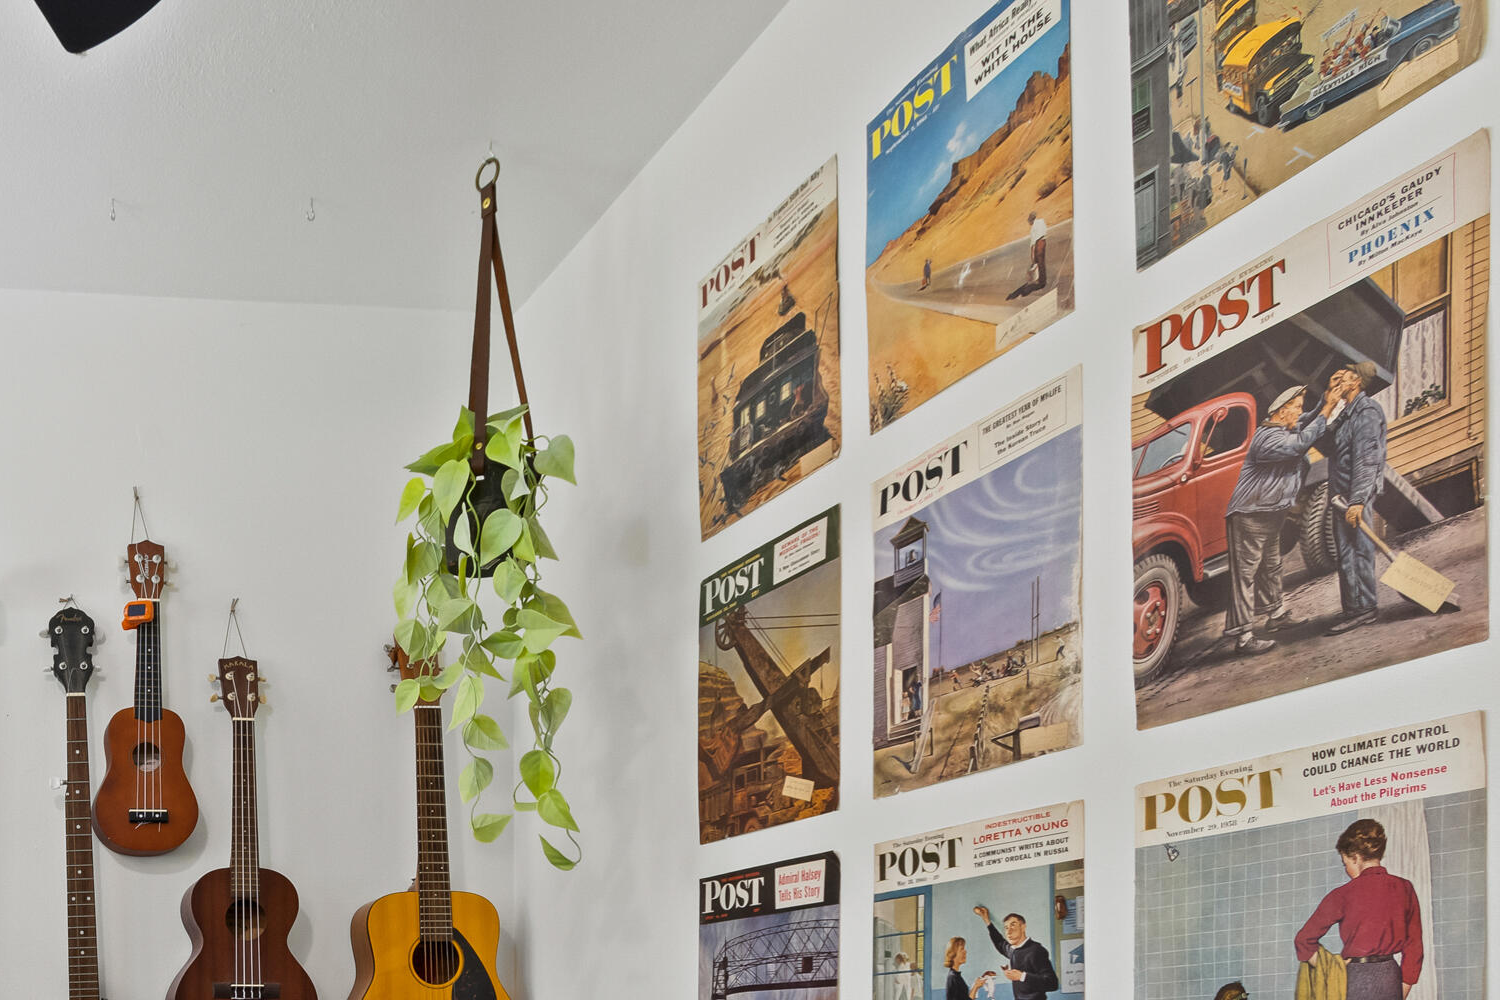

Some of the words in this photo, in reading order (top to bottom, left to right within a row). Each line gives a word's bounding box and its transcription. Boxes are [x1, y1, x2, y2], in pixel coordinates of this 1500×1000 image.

[969, 35, 987, 56] What
[989, 17, 1009, 39] Africa
[974, 50, 1009, 86] WHITE
[1012, 12, 1052, 52] HOUSE
[981, 44, 1002, 67] WIT
[1005, 32, 1016, 47] IN
[1020, 8, 1043, 32] THE
[871, 54, 958, 161] POST
[1337, 192, 1396, 231] CHICAGO'S
[1400, 166, 1443, 195] GAUDY
[1355, 187, 1423, 232] INNKEEPER
[1348, 206, 1435, 264] PHOENIX
[701, 231, 761, 309] POST
[1139, 258, 1286, 378] POST
[992, 409, 1018, 430] GREATEST
[1049, 384, 1062, 398] LIFE
[994, 439, 1005, 448] The
[1025, 419, 1041, 432] Story
[877, 440, 968, 518] POST
[703, 557, 764, 616] POST
[1302, 762, 1337, 777] COULD
[1340, 751, 1384, 770] CHANGE
[1389, 746, 1412, 760] THE
[1416, 737, 1461, 755] WORLD
[1312, 747, 1336, 761] HOW
[1339, 736, 1387, 755] CLIMATE
[1391, 724, 1449, 744] CONTROL
[1168, 780, 1181, 788] The
[1220, 764, 1254, 777] Evening
[1313, 784, 1336, 797] Let's
[1338, 781, 1362, 793] Have
[1364, 776, 1388, 787] Less
[1390, 764, 1448, 782] Nonsense
[1330, 794, 1358, 808] About
[1361, 791, 1377, 802] the
[1379, 782, 1427, 798] Pilgrims
[1139, 767, 1283, 832] POST
[973, 828, 1022, 846] LORETTA
[1025, 818, 1069, 834] YOUNG
[984, 811, 1051, 830] INDESTRUCTIBLE
[1165, 826, 1205, 838] November
[876, 836, 964, 882] POST
[979, 846, 1016, 859] COMMUNIST
[1018, 842, 1044, 852] WRITES
[1045, 837, 1069, 847] ABOUT
[1005, 853, 1032, 863] ORDEAL
[1033, 851, 1042, 859] IN
[1043, 846, 1069, 857] RUSSIA
[701, 877, 765, 914] POST
[778, 871, 800, 886] Admiral
[801, 868, 822, 882] Halsey
[778, 889, 792, 902] Tells
[793, 888, 803, 900] His
[804, 886, 820, 899] Story
